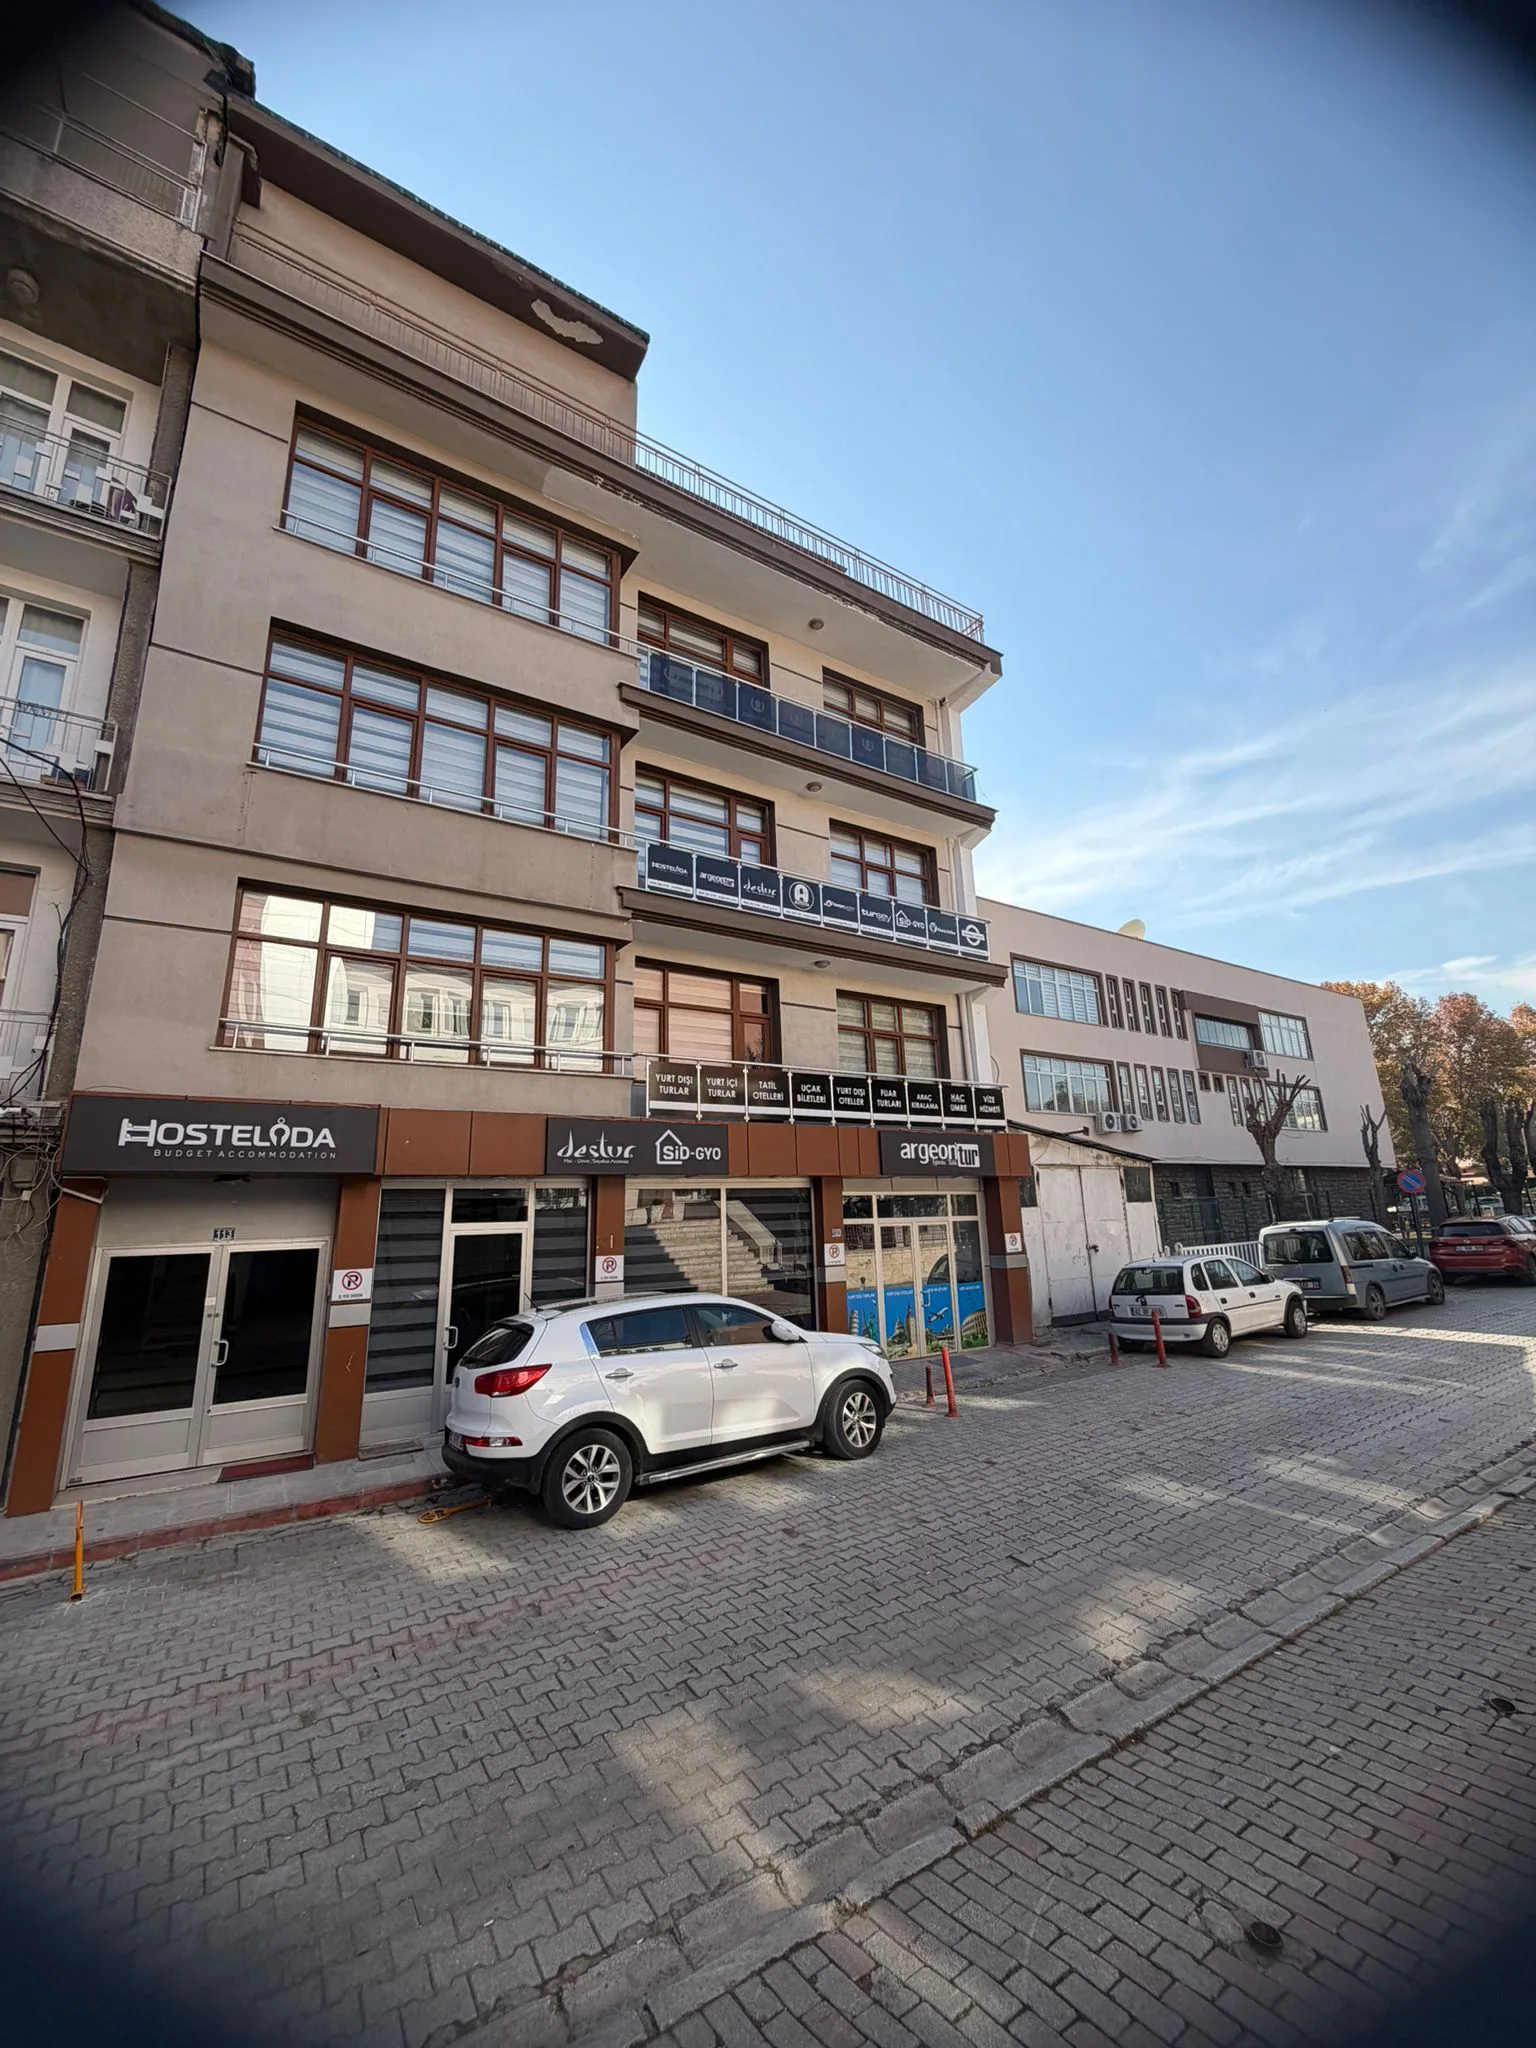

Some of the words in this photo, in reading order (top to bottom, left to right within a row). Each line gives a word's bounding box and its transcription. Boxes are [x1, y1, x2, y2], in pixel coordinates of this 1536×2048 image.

[655, 1073, 675, 1083] YURT
[677, 1075, 694, 1086] DIŞI
[706, 1077, 725, 1087] YURT
[726, 1077, 738, 1088] İÇİ
[758, 1080, 777, 1090] TATİL
[801, 1084, 821, 1093] UÇAK
[659, 1085, 690, 1096] TURLAR
[708, 1089, 736, 1098] TURLAR
[836, 1087, 852, 1095] YURT
[853, 1088, 866, 1097] DIŞI
[880, 1088, 897, 1098] FUAR
[752, 1091, 784, 1101] OTELLERİ
[796, 1094, 827, 1104] BİLETLERİ
[838, 1096, 865, 1106] OTELLER
[950, 1093, 965, 1103] HAC
[982, 1095, 996, 1104] VİZE
[876, 1099, 902, 1108] TURLARI
[911, 1102, 939, 1110] KİRALAMA
[949, 1104, 968, 1113] UMRE
[117, 1117, 336, 1148] HOSTELODA
[556, 1129, 638, 1159] destur
[153, 1149, 212, 1158] BUDGET
[218, 1151, 337, 1159] ACCOMMODATION
